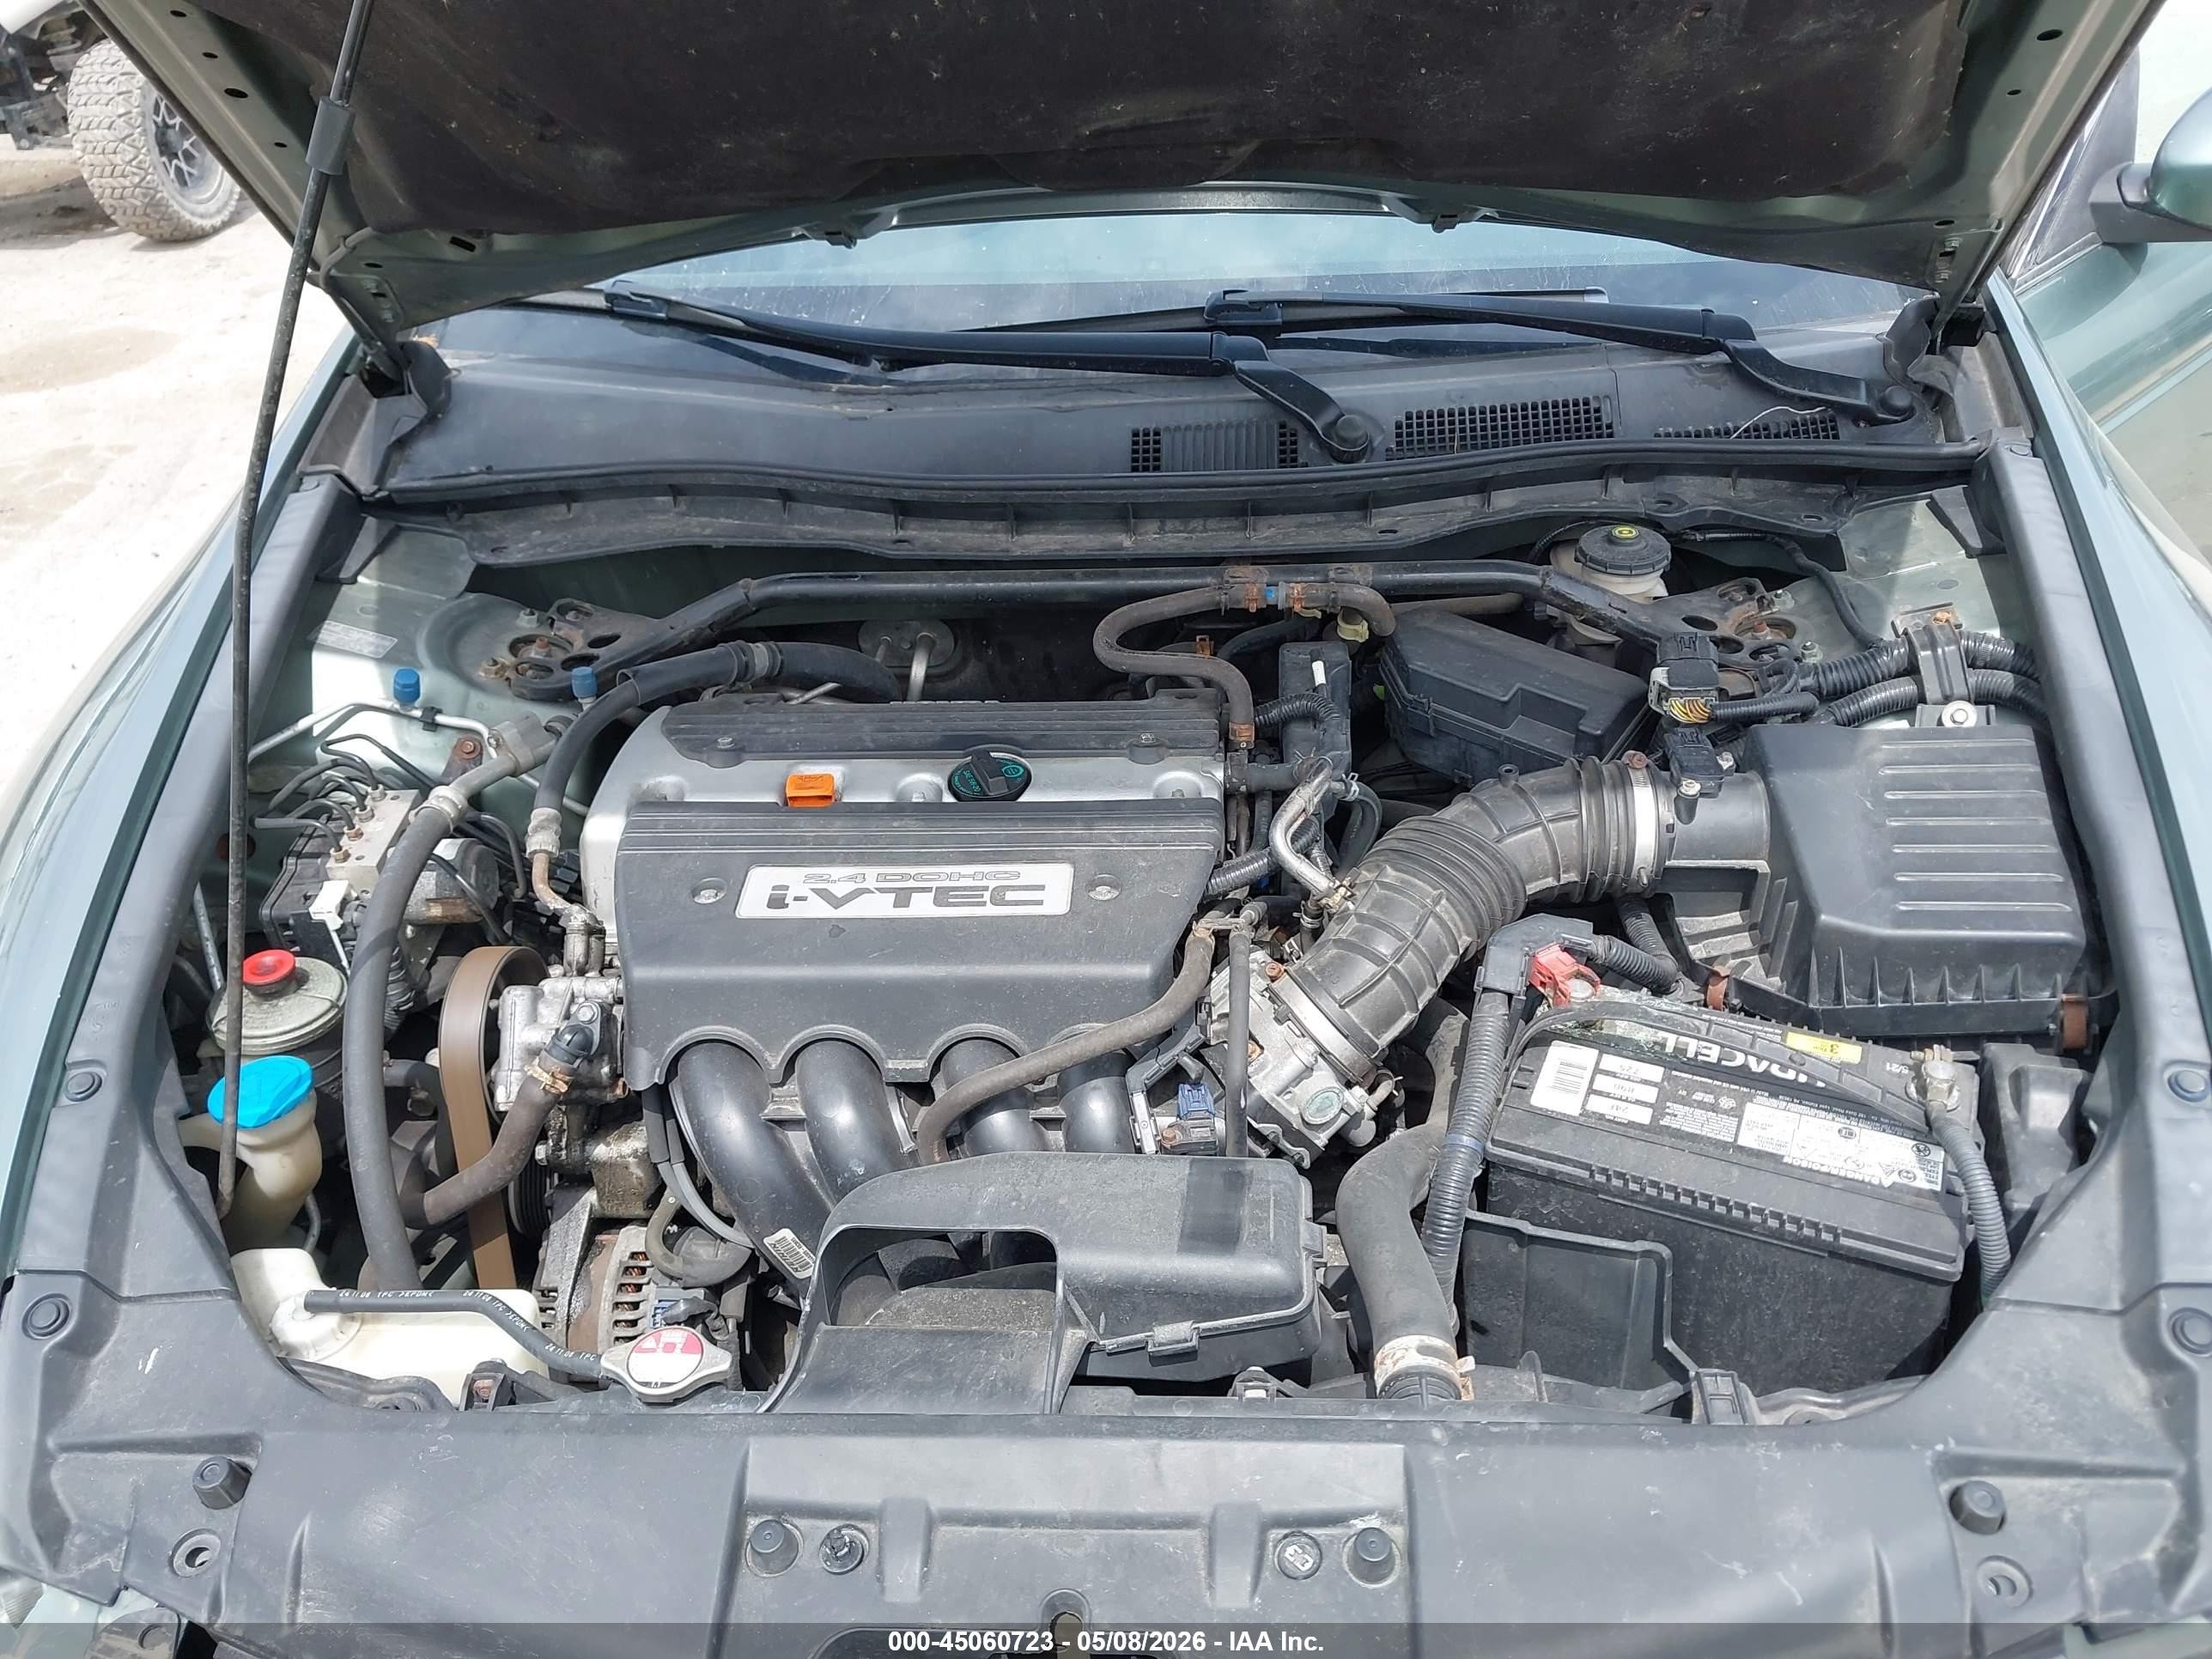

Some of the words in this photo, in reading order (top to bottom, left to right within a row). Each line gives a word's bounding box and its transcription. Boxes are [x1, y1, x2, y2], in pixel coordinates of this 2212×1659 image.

[804, 872, 868, 884] 2.4
[875, 872, 1021, 882] DOHC
[765, 884, 1046, 909] i-VTEC
[1885, 1060, 1909, 1074] 5/21
